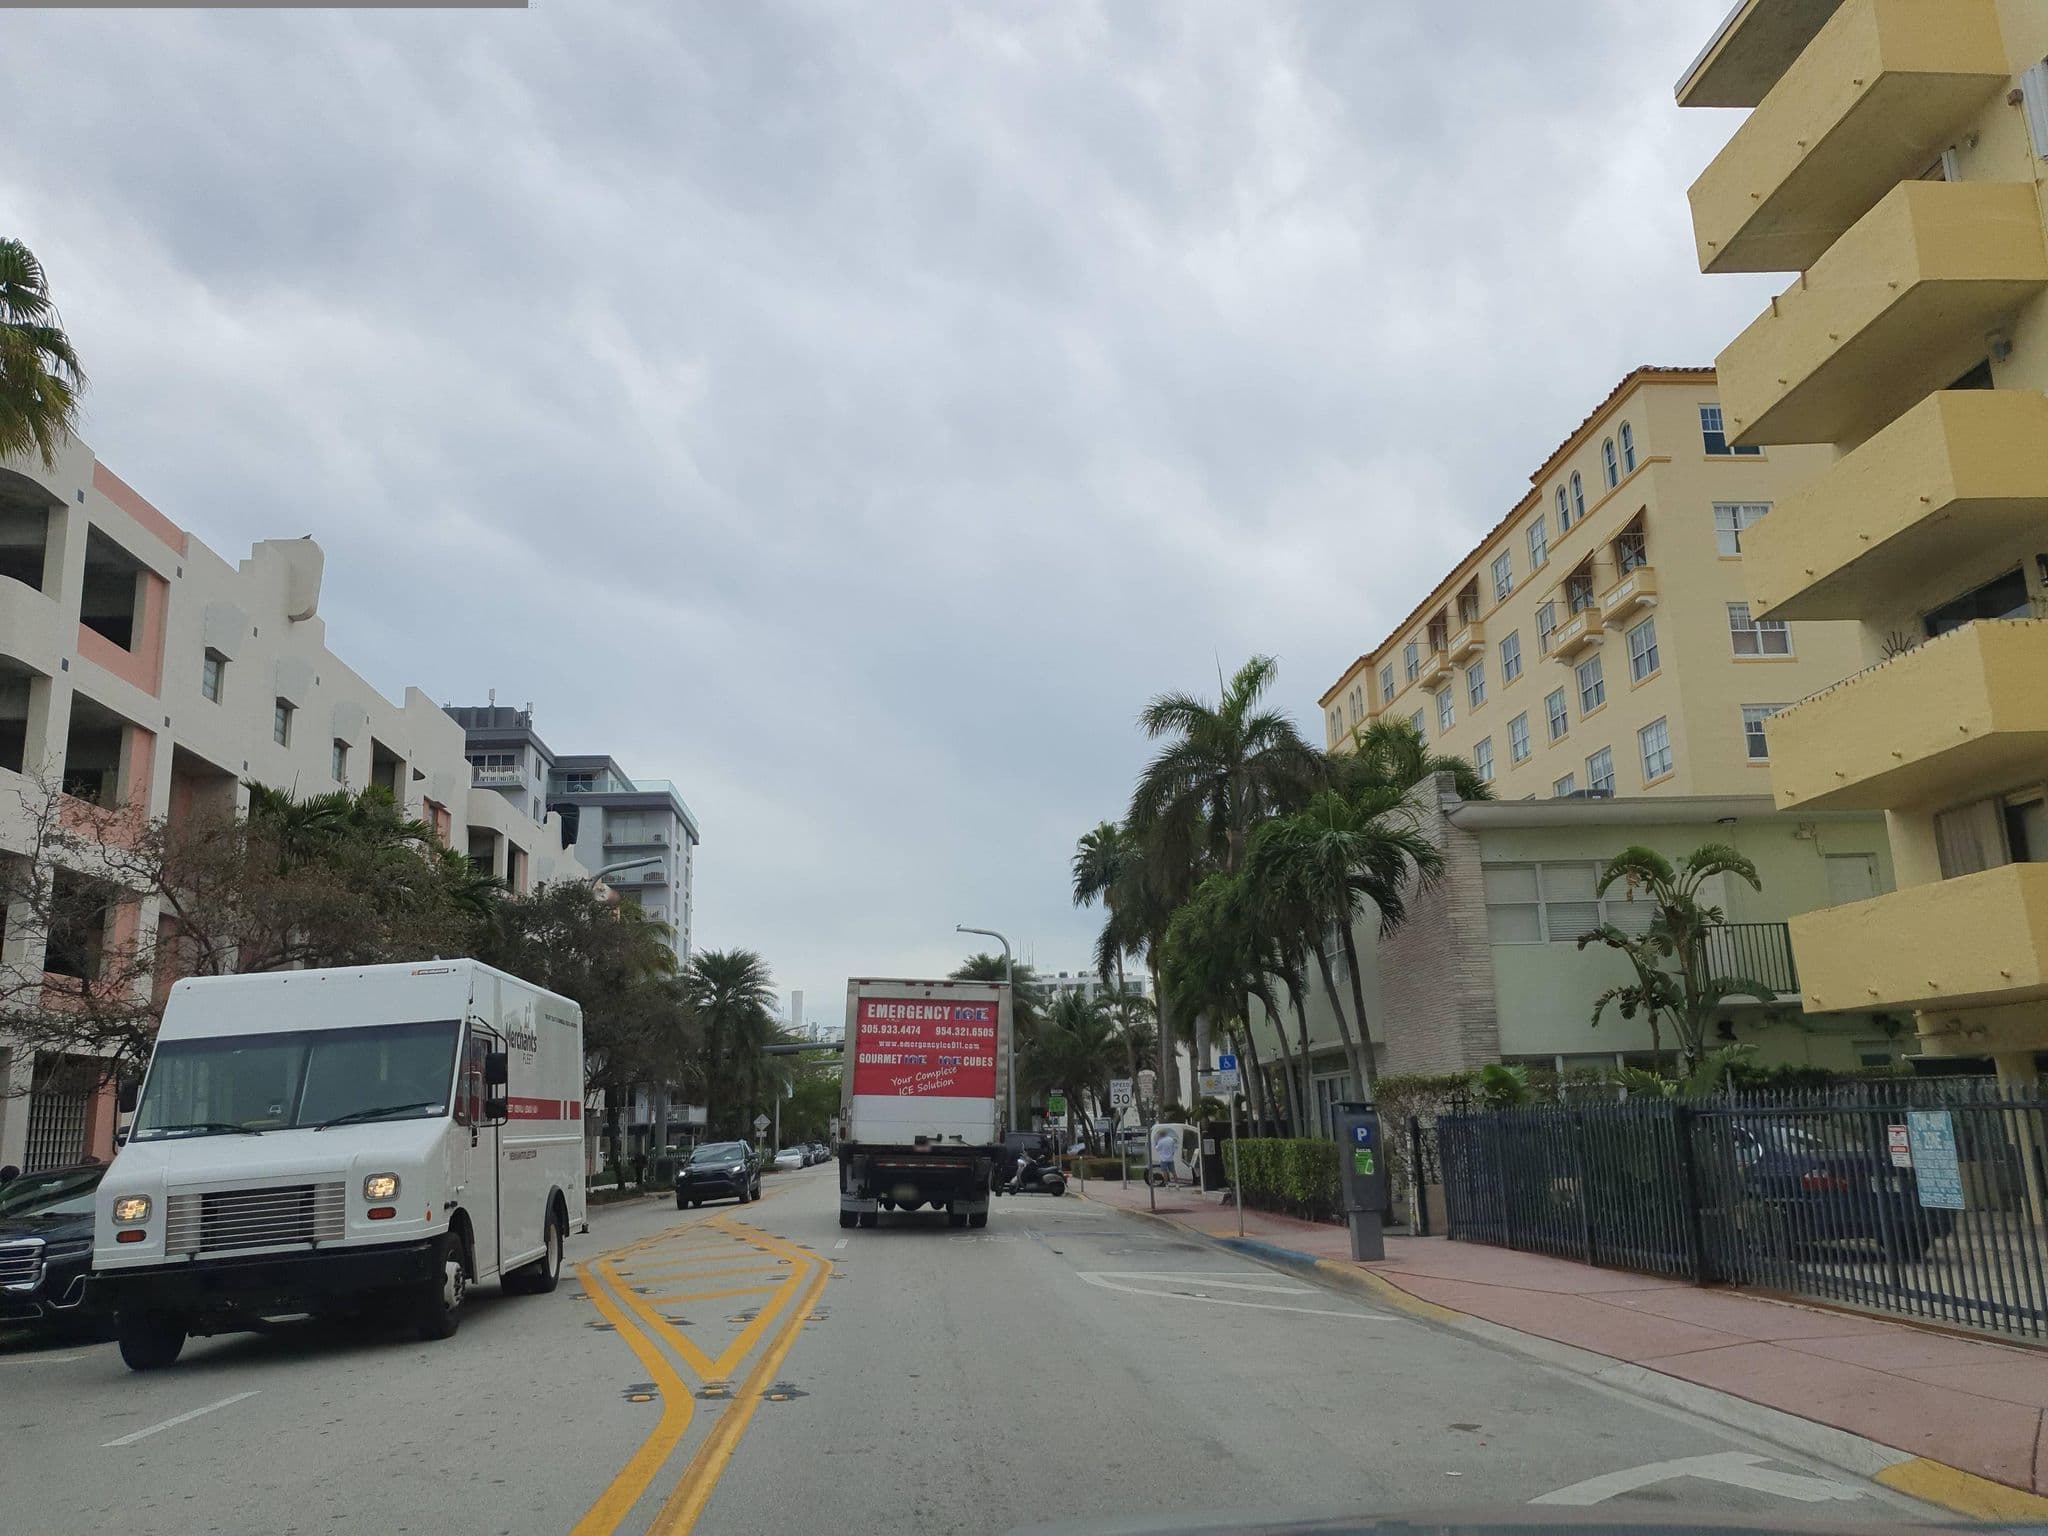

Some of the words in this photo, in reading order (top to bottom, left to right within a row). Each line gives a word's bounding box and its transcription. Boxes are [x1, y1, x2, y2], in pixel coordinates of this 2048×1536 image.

[867, 1004, 951, 1020] EMERGENCY
[954, 1007, 988, 1021] ICE
[861, 1025, 921, 1035] 305.933.4474
[505, 1023, 538, 1053] Merchants
[859, 1053, 903, 1064] GOURMET
[963, 1056, 993, 1067] CUBES
[890, 1076, 913, 1087] Your
[915, 1066, 958, 1082] Complete
[898, 1086, 914, 1097] ICE
[917, 1079, 954, 1093] Solution
[1113, 1094, 1130, 1104] 30
[1356, 1128, 1367, 1141] P
